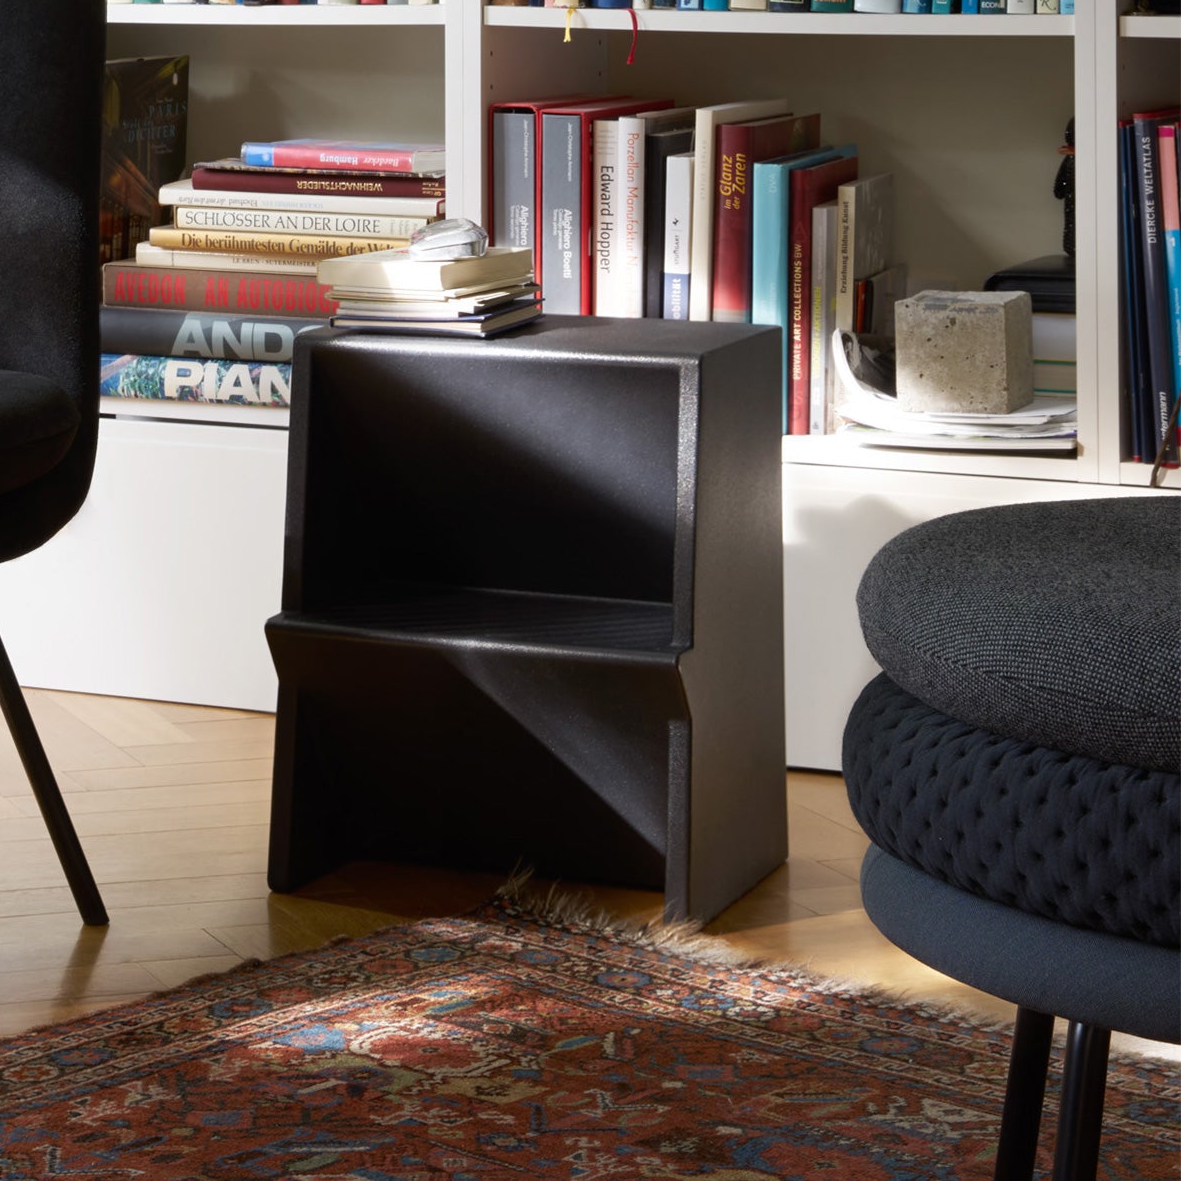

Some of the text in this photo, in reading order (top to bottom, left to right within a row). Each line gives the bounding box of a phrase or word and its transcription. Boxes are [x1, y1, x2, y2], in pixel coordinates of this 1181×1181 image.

[320, 154, 359, 165] Hamburg
[627, 132, 639, 183] Porzellan
[720, 155, 733, 196] Glanz
[733, 153, 747, 194] Zaren
[296, 180, 383, 193] WEIHNACHTSLIEDER
[1141, 136, 1157, 243] DIERCKE WELTATLAS
[185, 209, 381, 234] SCHLÖSSER AN DER LOIRE
[519, 205, 529, 245] Alighiero
[597, 166, 614, 273] Edward Hopper
[626, 187, 639, 251] Manufaktur
[181, 232, 365, 256] Die berühmtesten Gemälde der
[562, 209, 572, 278] Alighiero Boetti
[115, 273, 340, 315] AVEDON AN AUTOBIOG
[793, 260, 802, 340] ART COLLECTIONS
